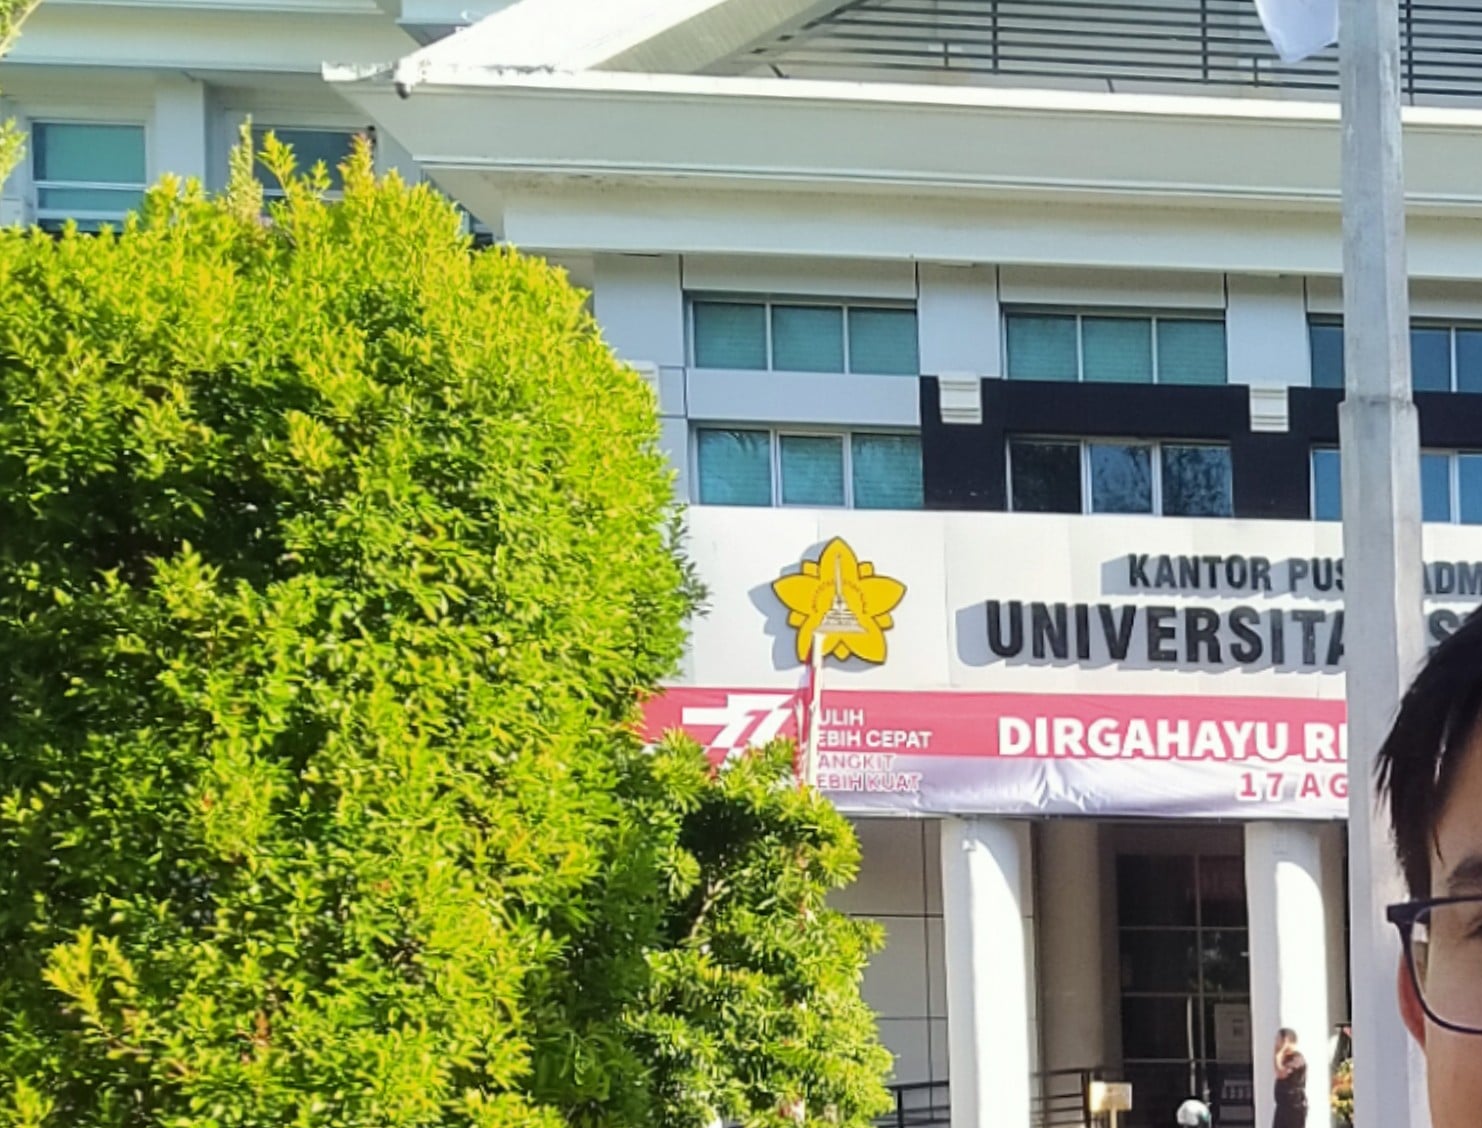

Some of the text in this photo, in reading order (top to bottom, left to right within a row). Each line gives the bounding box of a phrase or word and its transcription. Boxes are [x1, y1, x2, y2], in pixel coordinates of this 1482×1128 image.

[1127, 553, 1272, 592] KANTOR
[817, 729, 933, 748] EBIH CEPAT
[998, 715, 1290, 761] DIRGAHAYU
[817, 753, 894, 770] ANGKIT
[816, 773, 920, 791] EBIH KUAT
[1239, 772, 1285, 798] 17
